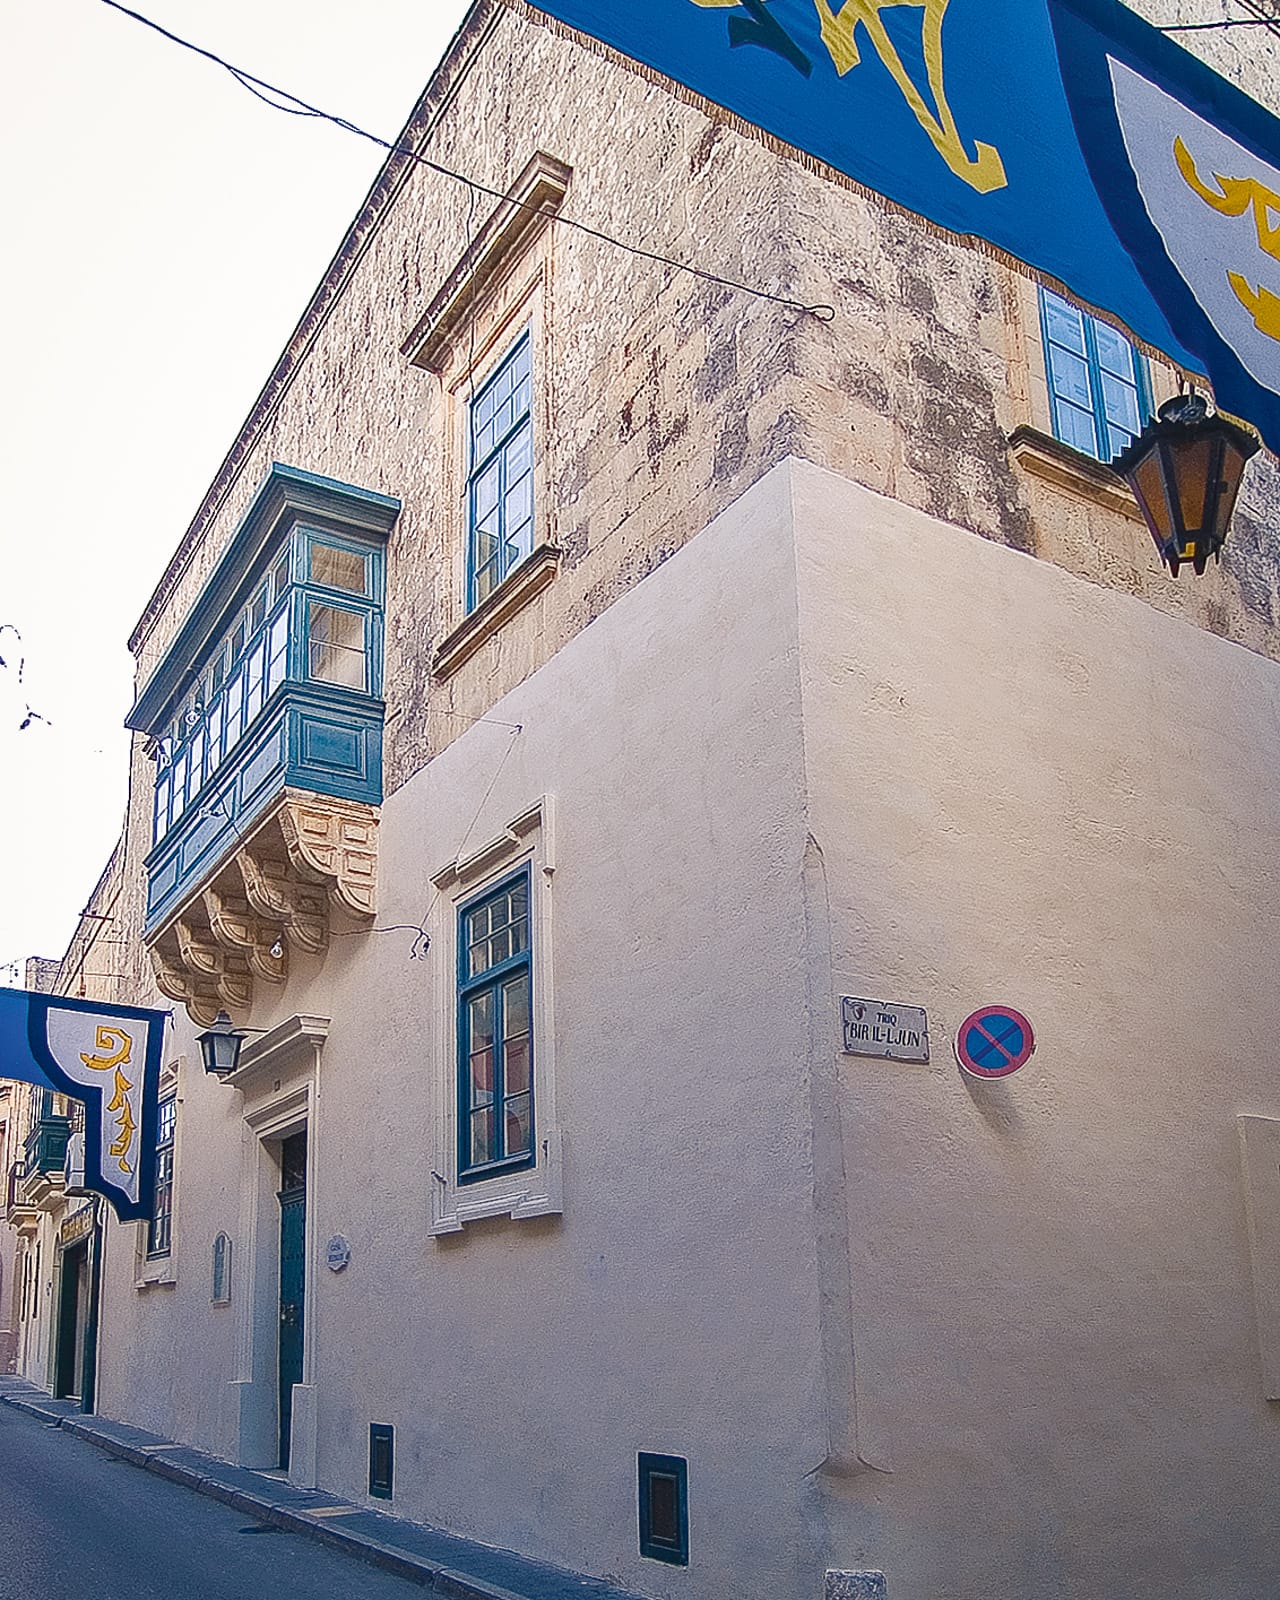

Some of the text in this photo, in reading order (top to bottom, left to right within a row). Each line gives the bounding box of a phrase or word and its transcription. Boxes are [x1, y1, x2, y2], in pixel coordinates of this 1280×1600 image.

[876, 1011, 897, 1027] TRIQ
[850, 1022, 920, 1047] BIR IL-LJUN
